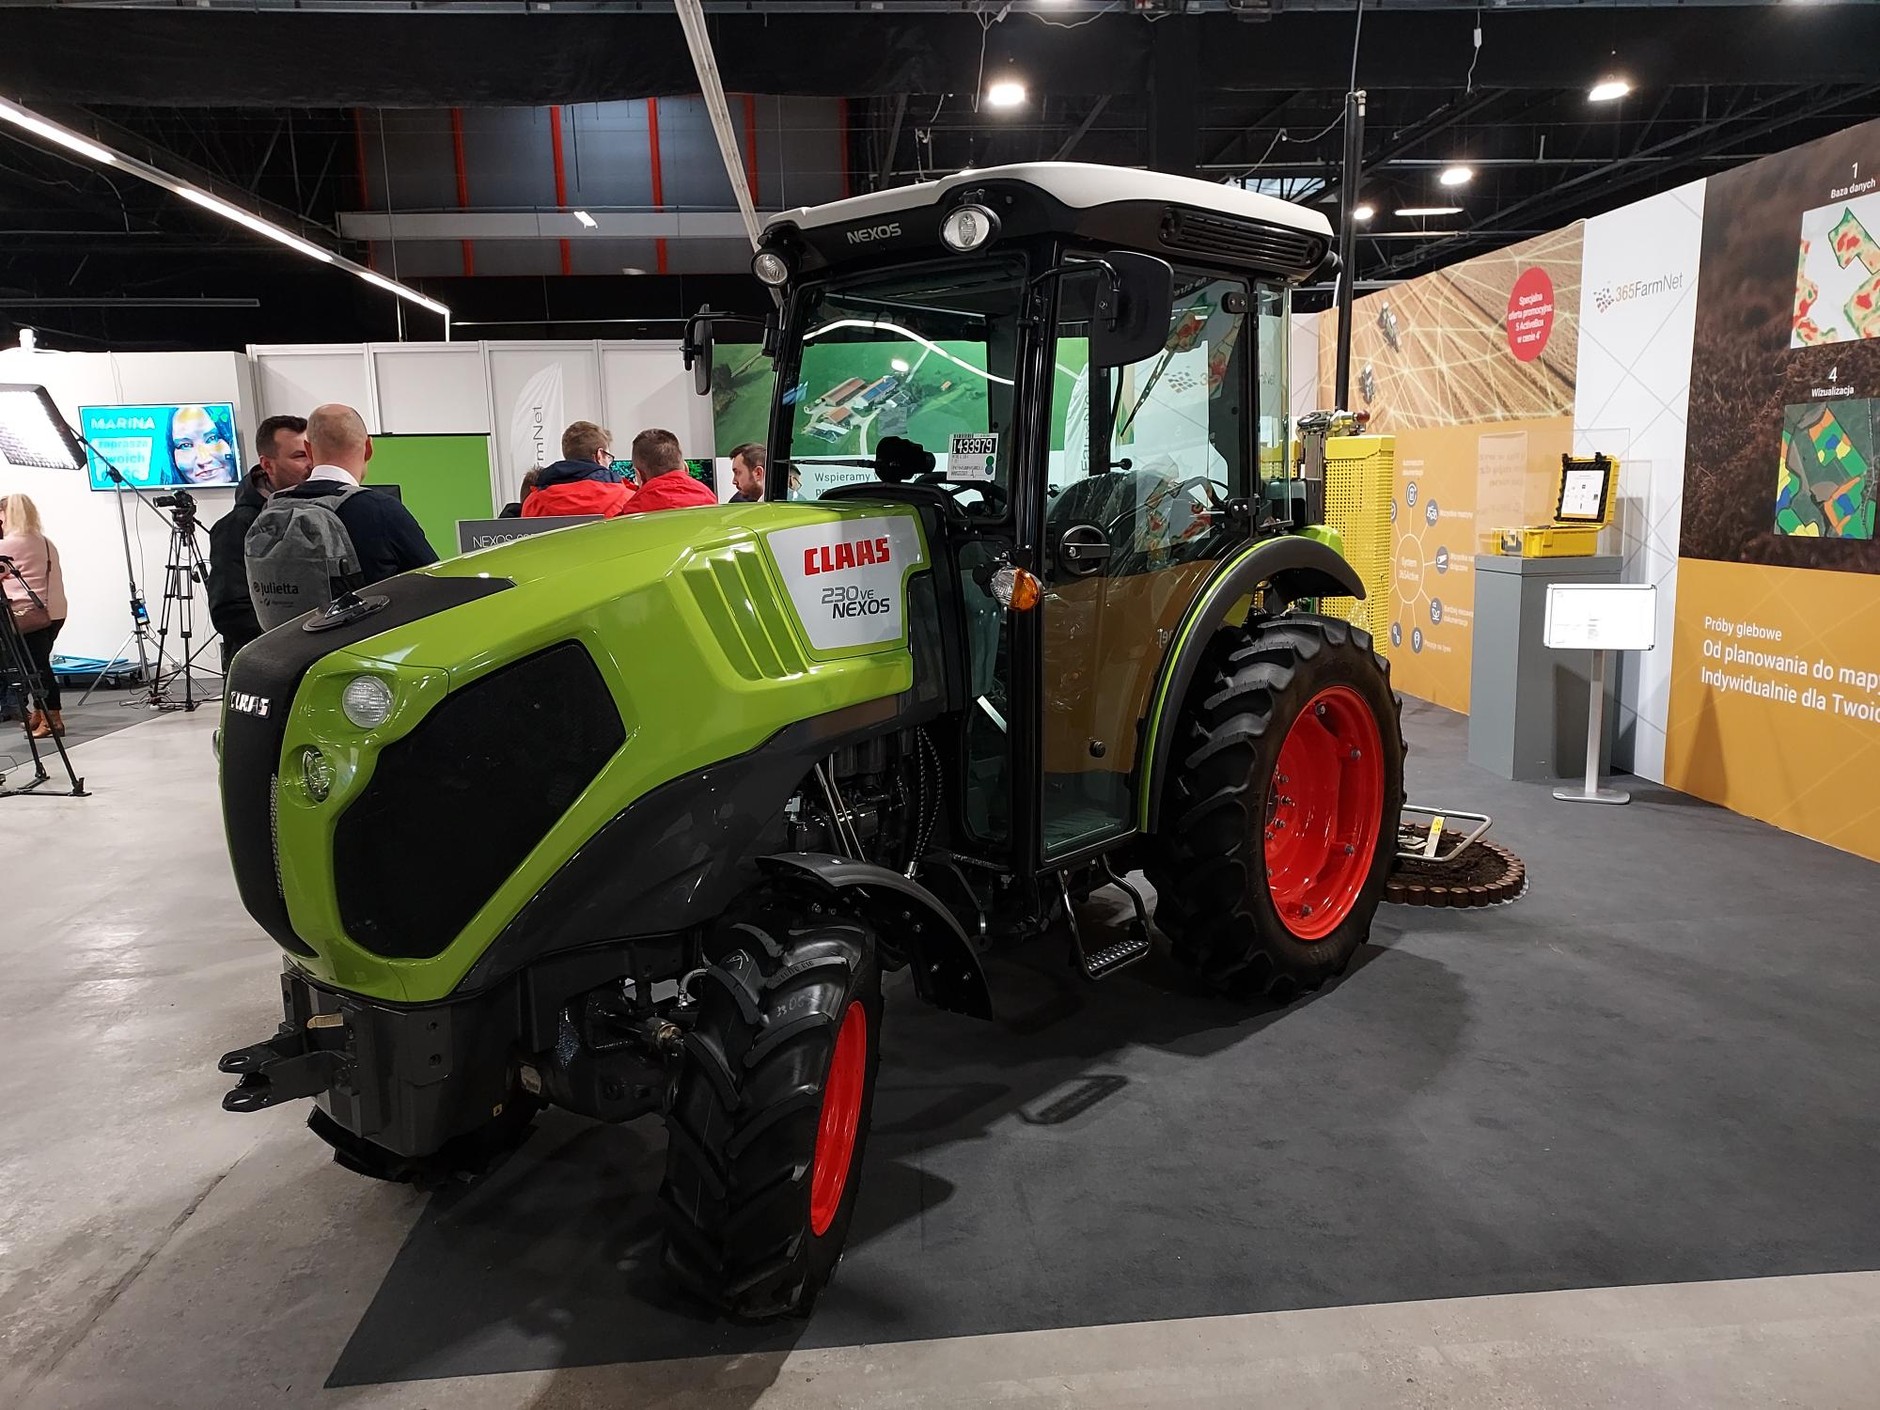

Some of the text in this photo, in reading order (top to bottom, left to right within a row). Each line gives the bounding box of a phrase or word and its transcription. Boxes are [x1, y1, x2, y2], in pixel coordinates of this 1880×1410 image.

[1852, 162, 1858, 179] 1
[1831, 178, 1876, 199] Baza danych
[846, 222, 902, 244] NEXOS
[1615, 272, 1683, 302] 365FarmNet
[1828, 366, 1838, 382] 4
[1811, 385, 1855, 398] Wizualizacja
[90, 415, 156, 430] MARINA
[952, 438, 993, 454] 1433979
[815, 472, 871, 484] Wspieramy
[804, 537, 890, 576] CLAAS
[821, 585, 859, 604] 230
[832, 598, 890, 619] NEXOS
[1704, 616, 1783, 641] Próby glebowe
[1703, 639, 1721, 658] Od
[1724, 643, 1808, 676] planowania
[1812, 659, 1834, 681] do
[1701, 666, 1797, 704] Indywidualnie
[1801, 688, 1826, 710] dla
